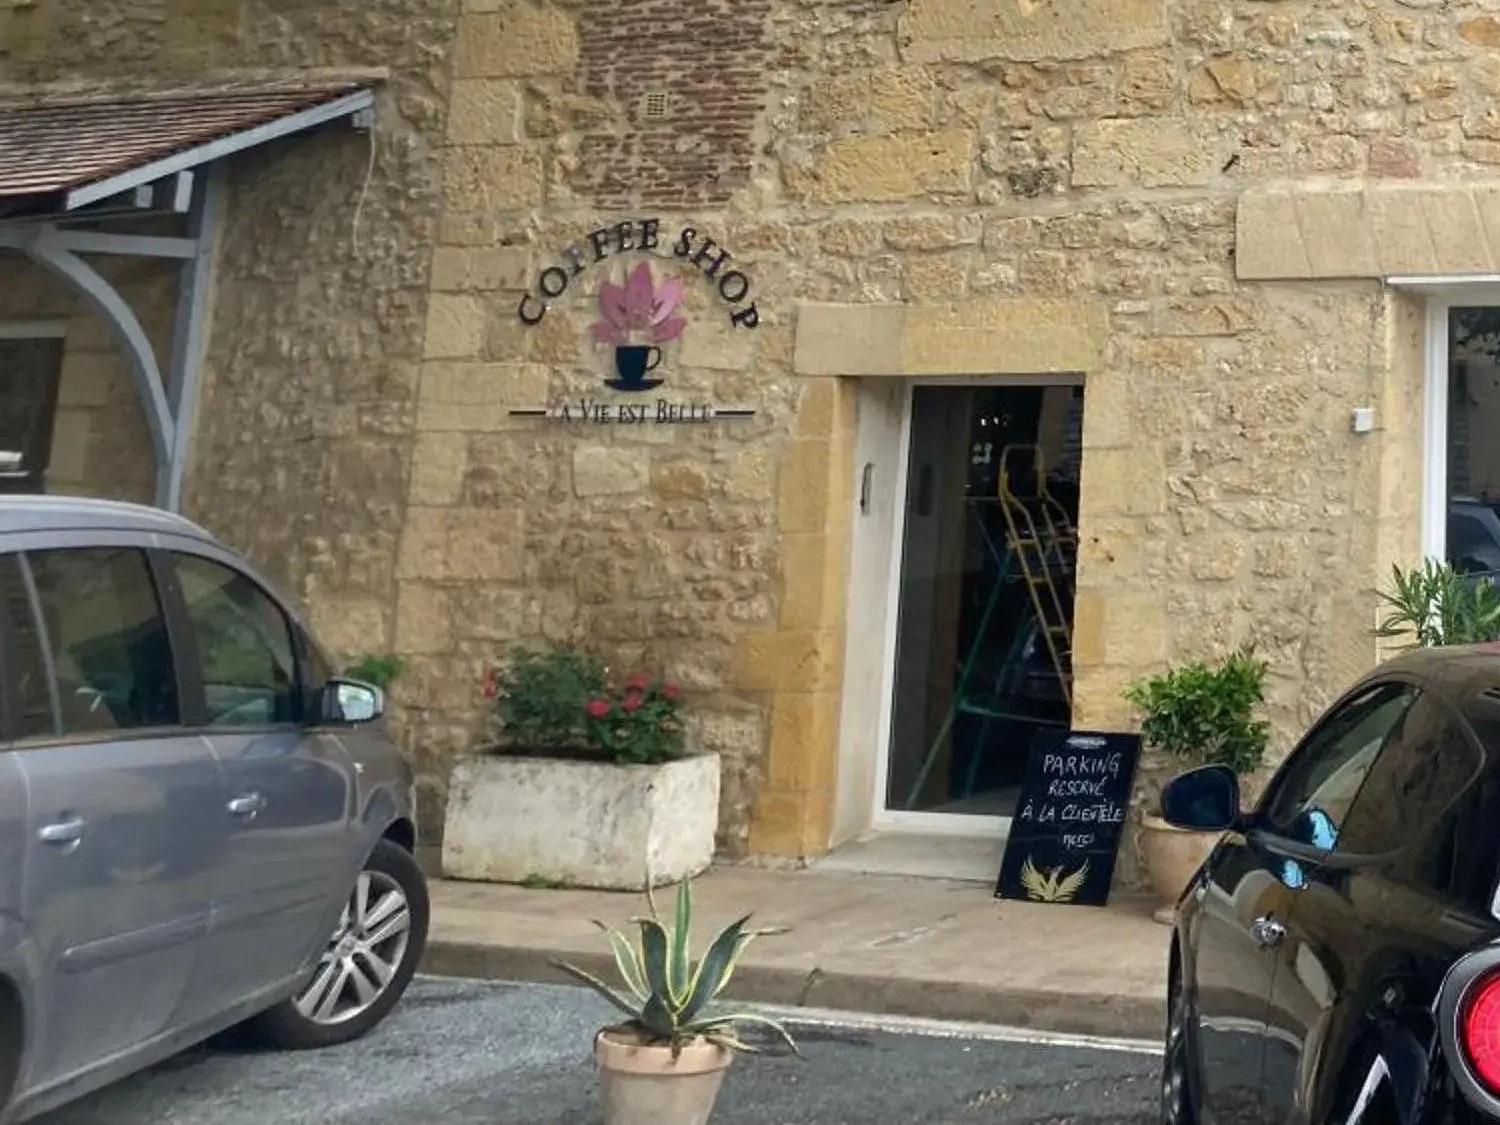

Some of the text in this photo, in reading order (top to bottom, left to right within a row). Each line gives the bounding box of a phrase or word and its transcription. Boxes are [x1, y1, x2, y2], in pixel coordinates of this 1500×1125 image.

[673, 228, 760, 329] SHOP
[618, 404, 650, 424] EST
[1043, 752, 1121, 779] PARKING
[1038, 804, 1055, 822] LA
